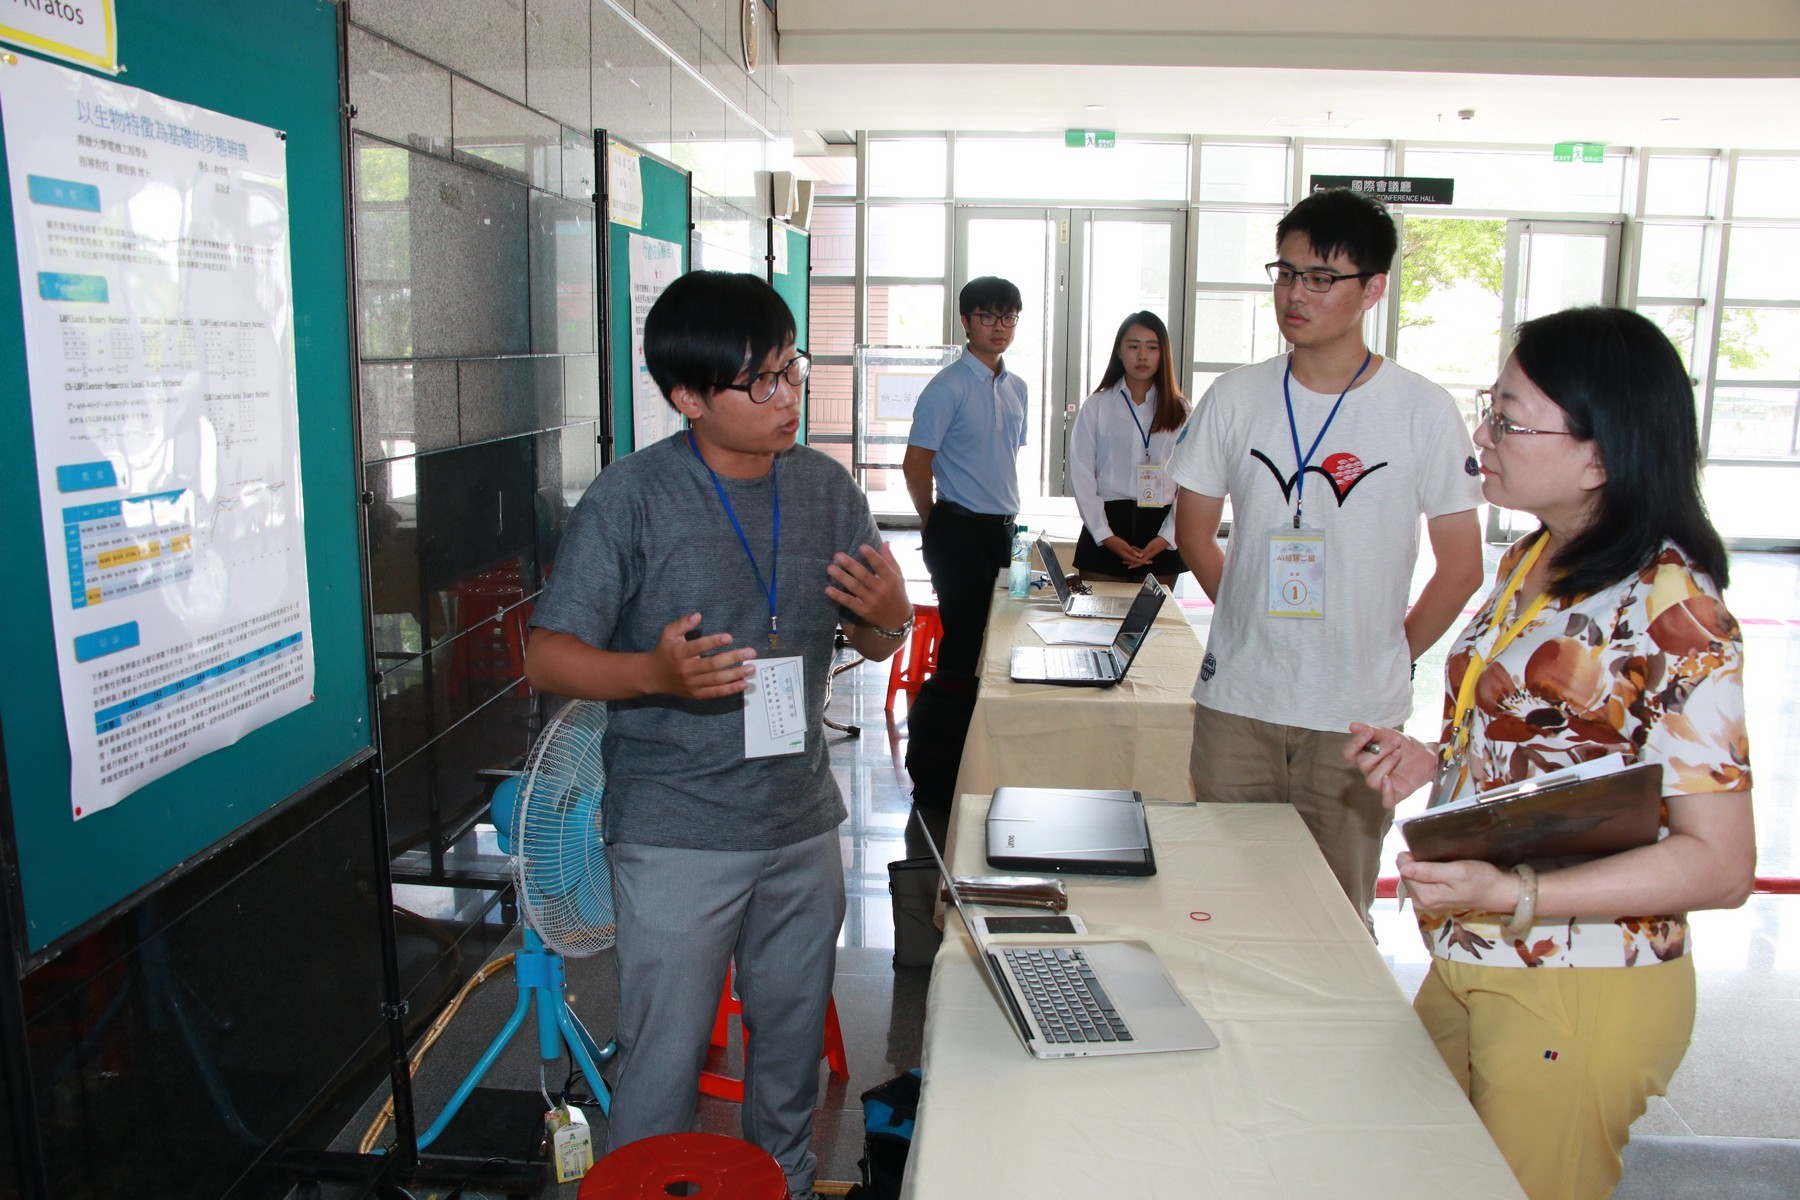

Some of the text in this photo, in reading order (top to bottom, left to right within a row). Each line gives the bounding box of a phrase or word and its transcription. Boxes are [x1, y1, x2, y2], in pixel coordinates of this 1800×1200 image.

[1351, 180, 1412, 193] 國際會議廳
[1146, 491, 1152, 499] 2
[1292, 585, 1298, 600] 1
